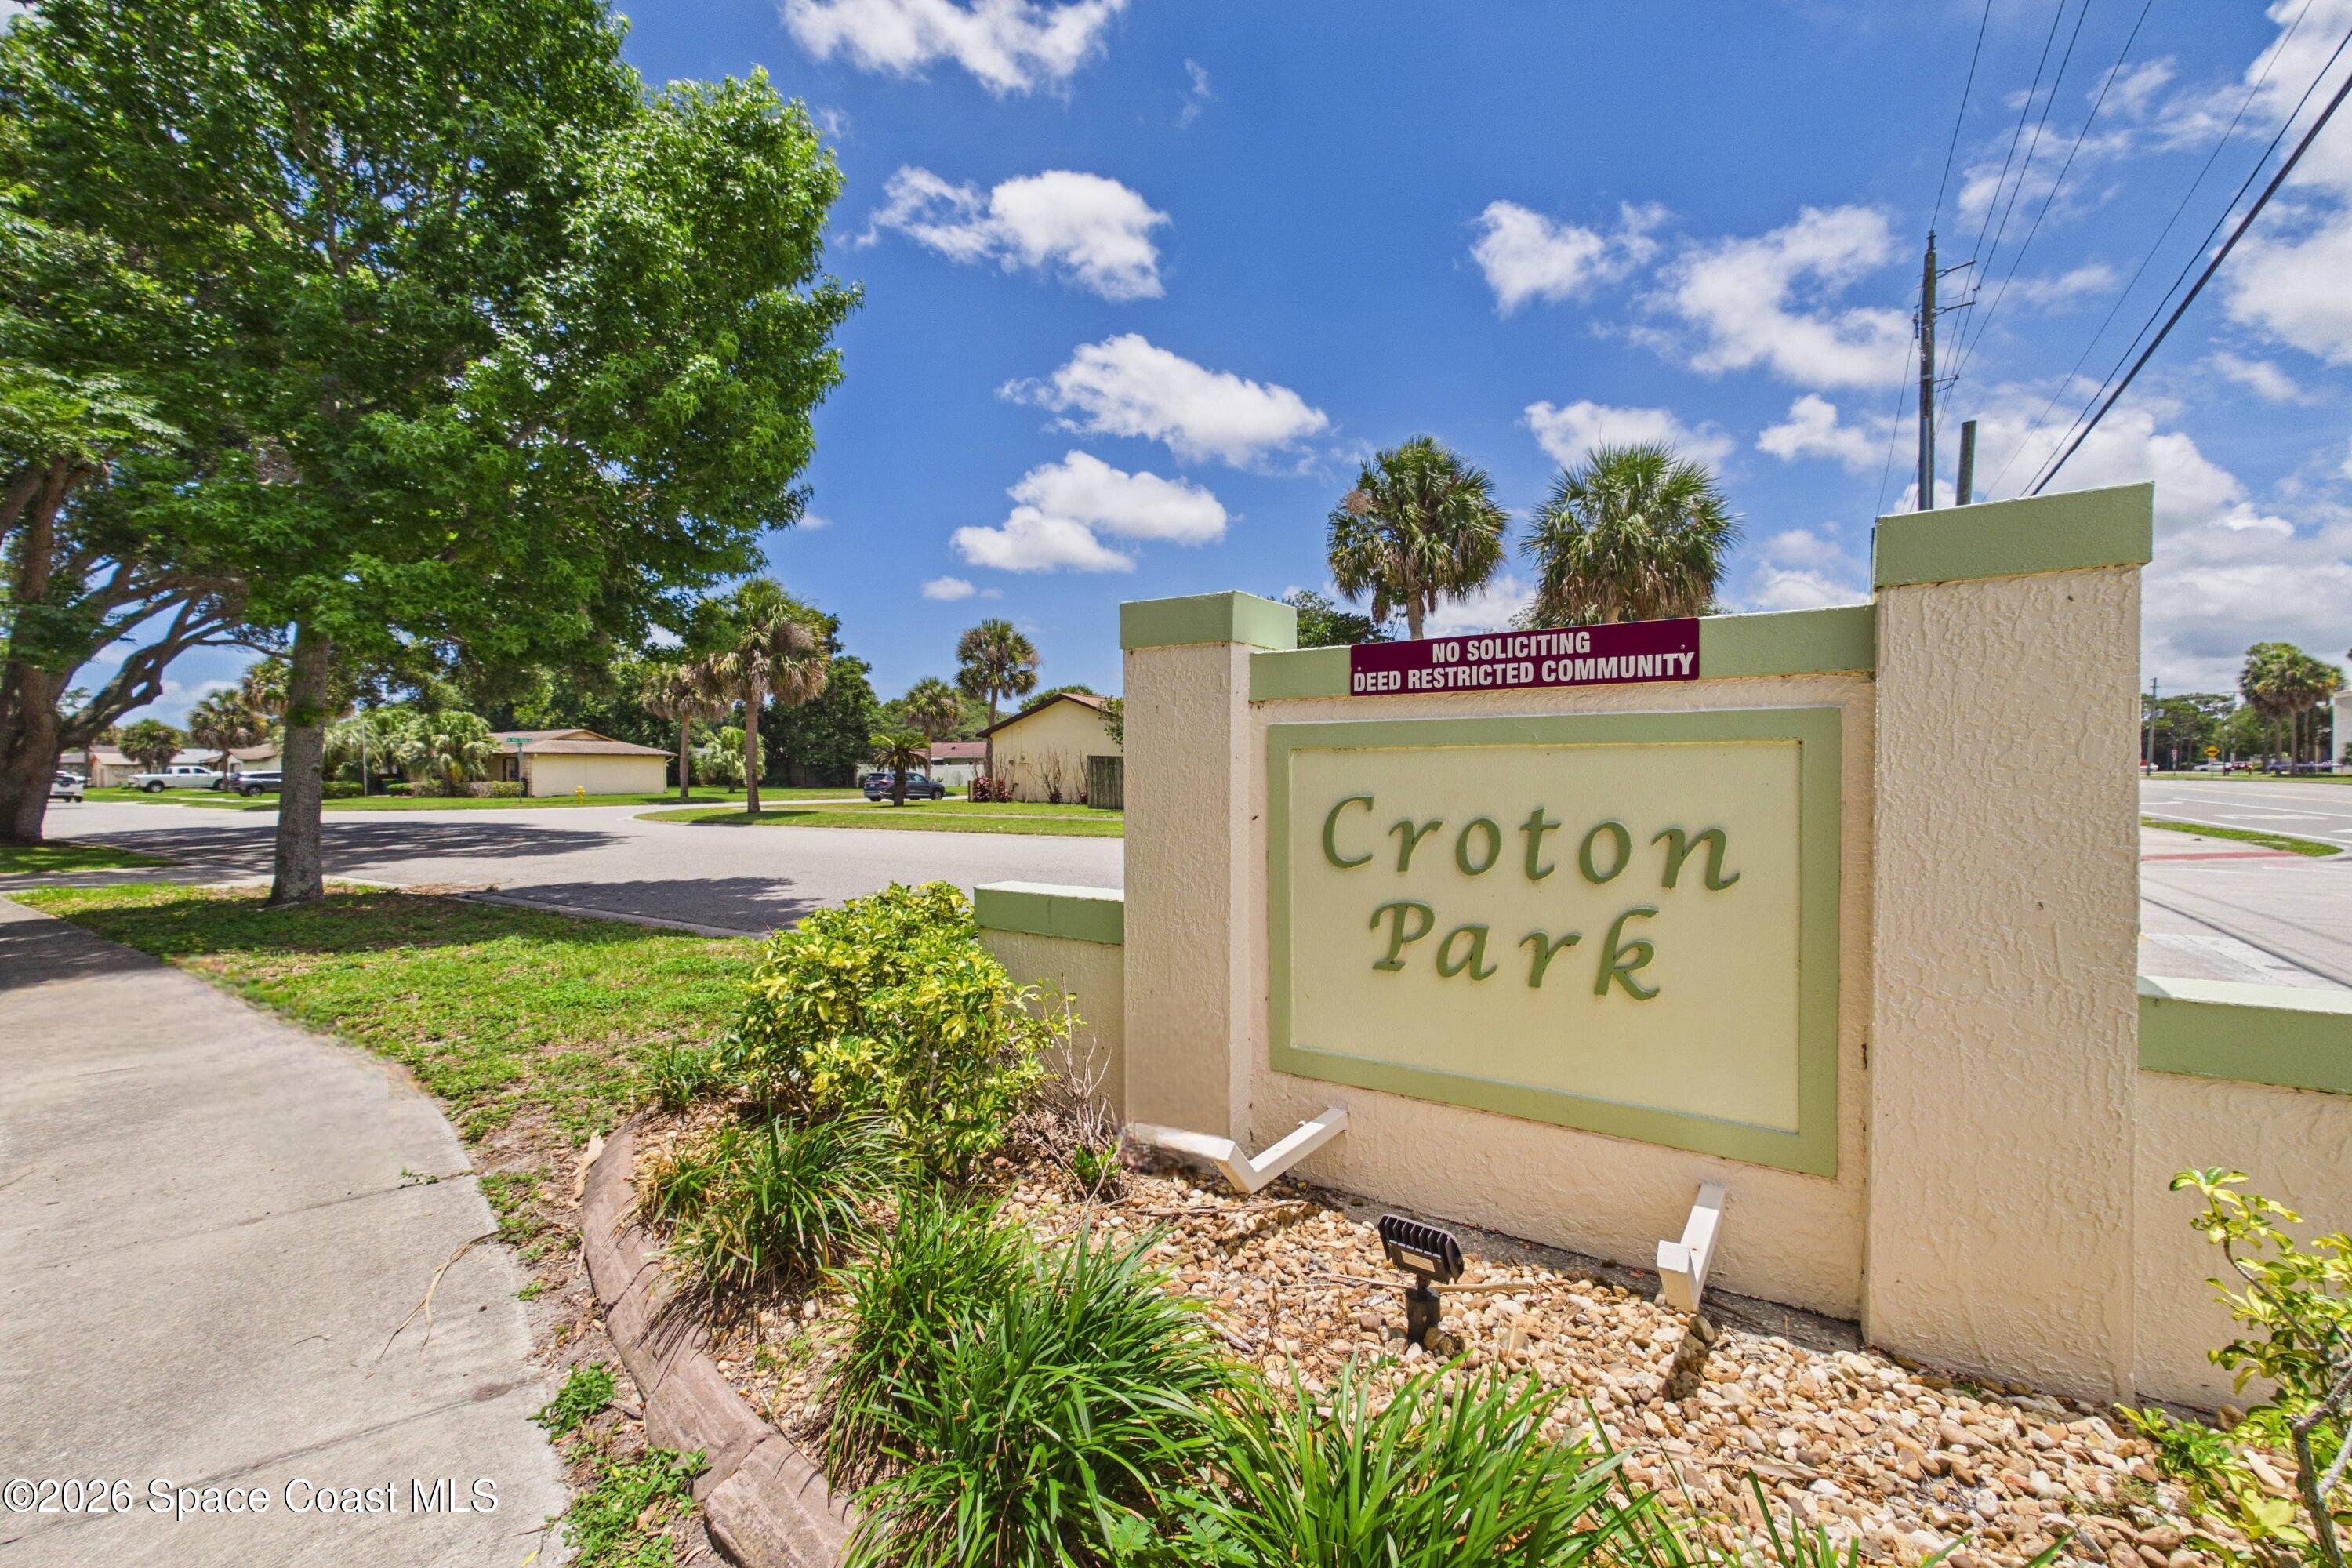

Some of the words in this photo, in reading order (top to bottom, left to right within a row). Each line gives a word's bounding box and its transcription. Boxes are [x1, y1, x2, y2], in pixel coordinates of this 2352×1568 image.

[1353, 671, 1401, 692] DEED
[1407, 662, 1534, 689] RESTRICTED
[1541, 652, 1694, 681] COMMUNITY
[1432, 642, 1460, 663] NO
[1467, 632, 1591, 660] SOLICITING
[1322, 794, 1740, 891] Croton
[1369, 901, 1661, 1001] Park
